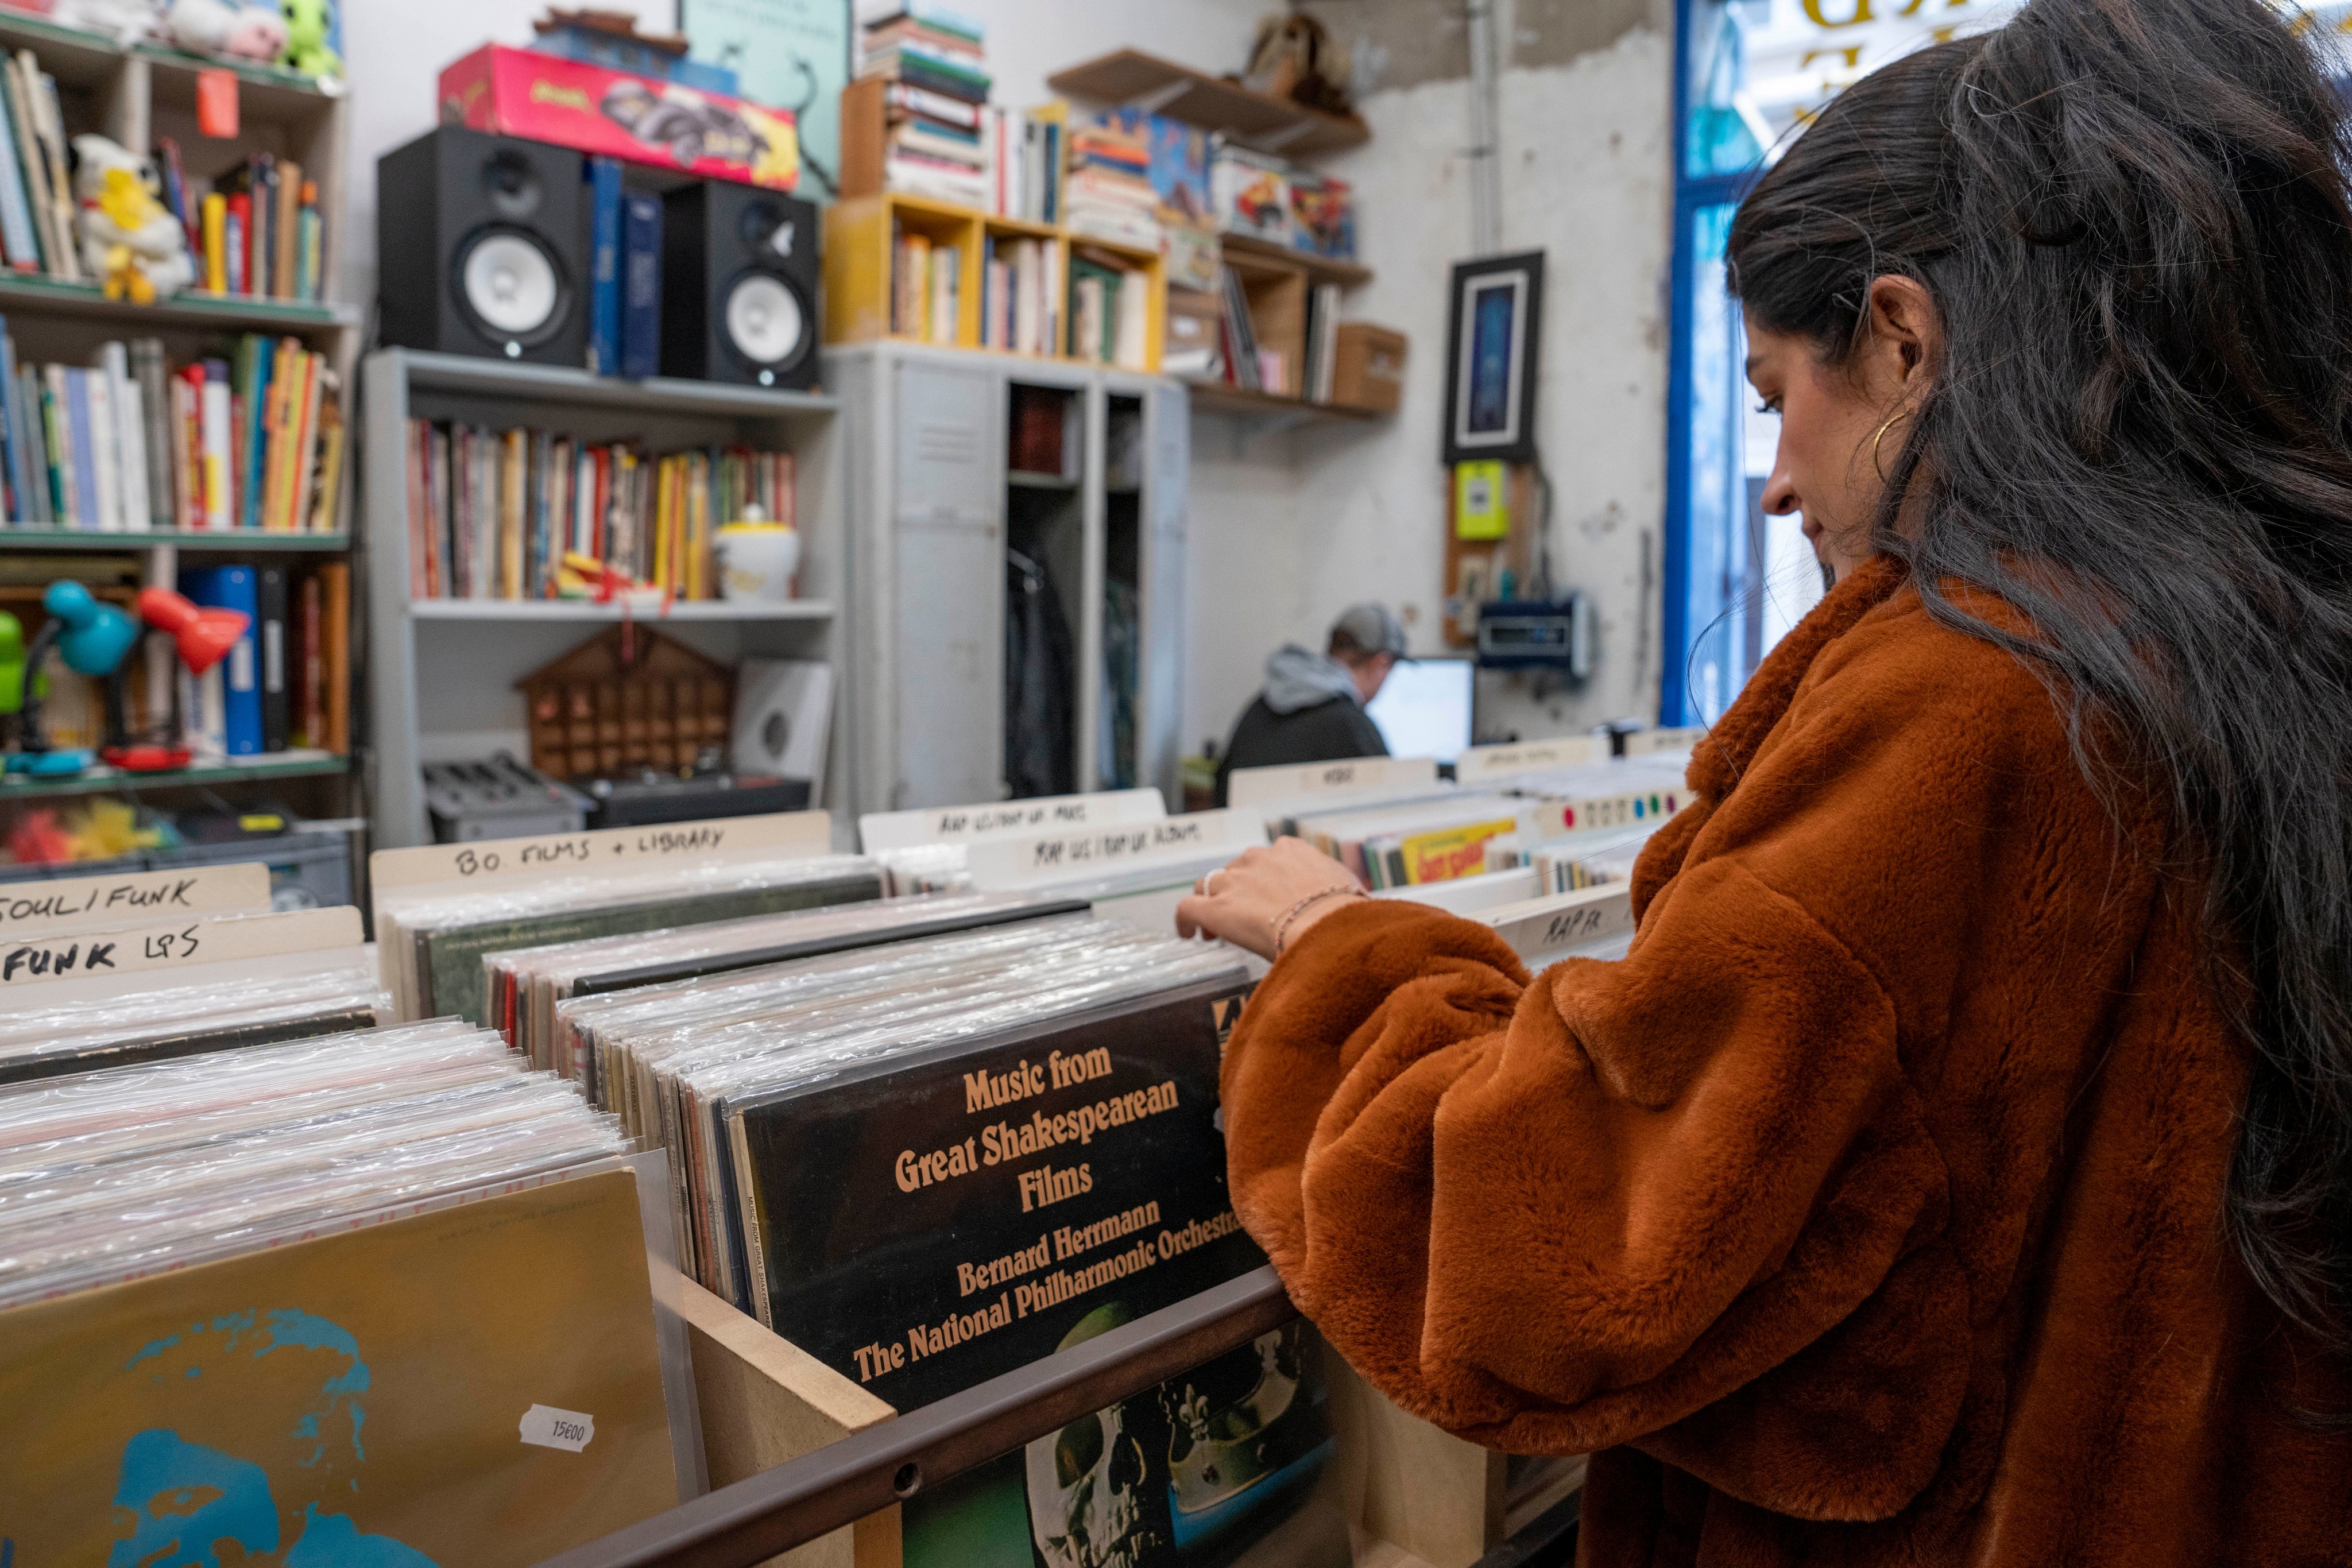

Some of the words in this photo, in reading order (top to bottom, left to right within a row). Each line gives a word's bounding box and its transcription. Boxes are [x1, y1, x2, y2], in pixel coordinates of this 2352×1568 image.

[521, 839, 590, 862] FILMS
[638, 827, 725, 853] LIBRARY
[1543, 908, 1584, 944] RAP
[3, 943, 116, 981] FUNK
[963, 1059, 1046, 1114] Music
[1049, 1046, 1113, 1090] from
[895, 1135, 978, 1193] Great
[981, 1080, 1179, 1166] Shakespearean
[1017, 1163, 1093, 1213] Films
[748, 1197, 756, 1220] MUSIC
[752, 1222, 760, 1243] FROM
[957, 1234, 1051, 1298] Bernard
[1053, 1200, 1160, 1261] Herrmann
[755, 1246, 763, 1270] GREAT
[853, 1341, 906, 1383] The
[907, 1292, 1012, 1363] National
[1013, 1239, 1157, 1319] Philharmonic
[554, 1420, 585, 1442] 15€00
